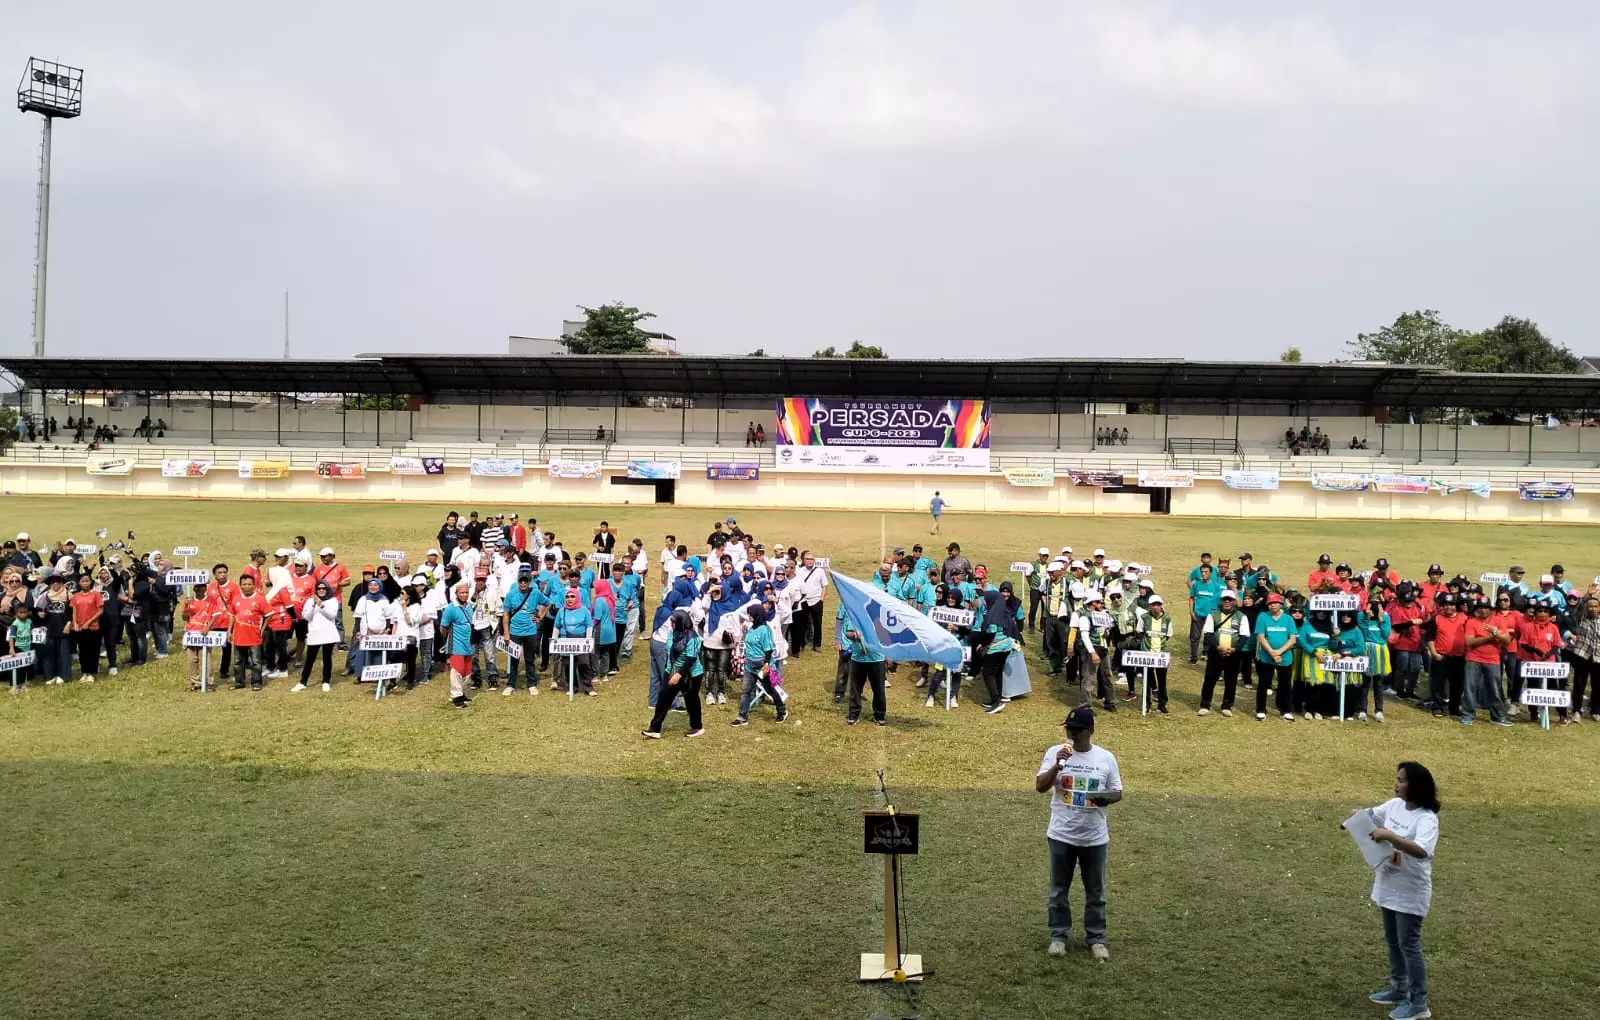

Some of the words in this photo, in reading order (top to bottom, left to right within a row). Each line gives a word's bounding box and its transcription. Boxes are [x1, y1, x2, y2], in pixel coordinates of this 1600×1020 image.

[844, 402, 922, 410] TOURNAMENT
[811, 408, 955, 429] PERSADA
[170, 575, 197, 583] PERSADA
[199, 575, 206, 583] 91
[1315, 600, 1345, 608] PERSADA
[932, 612, 960, 623] PERSADA
[186, 636, 213, 644] PERSADA
[553, 644, 580, 652] PERSADA
[1126, 656, 1155, 665] PERSADA
[1324, 661, 1353, 670] PERSADA
[365, 671, 388, 679] PERSADA
[1526, 668, 1555, 676] PERSADA
[1527, 695, 1556, 704] PERSADA
